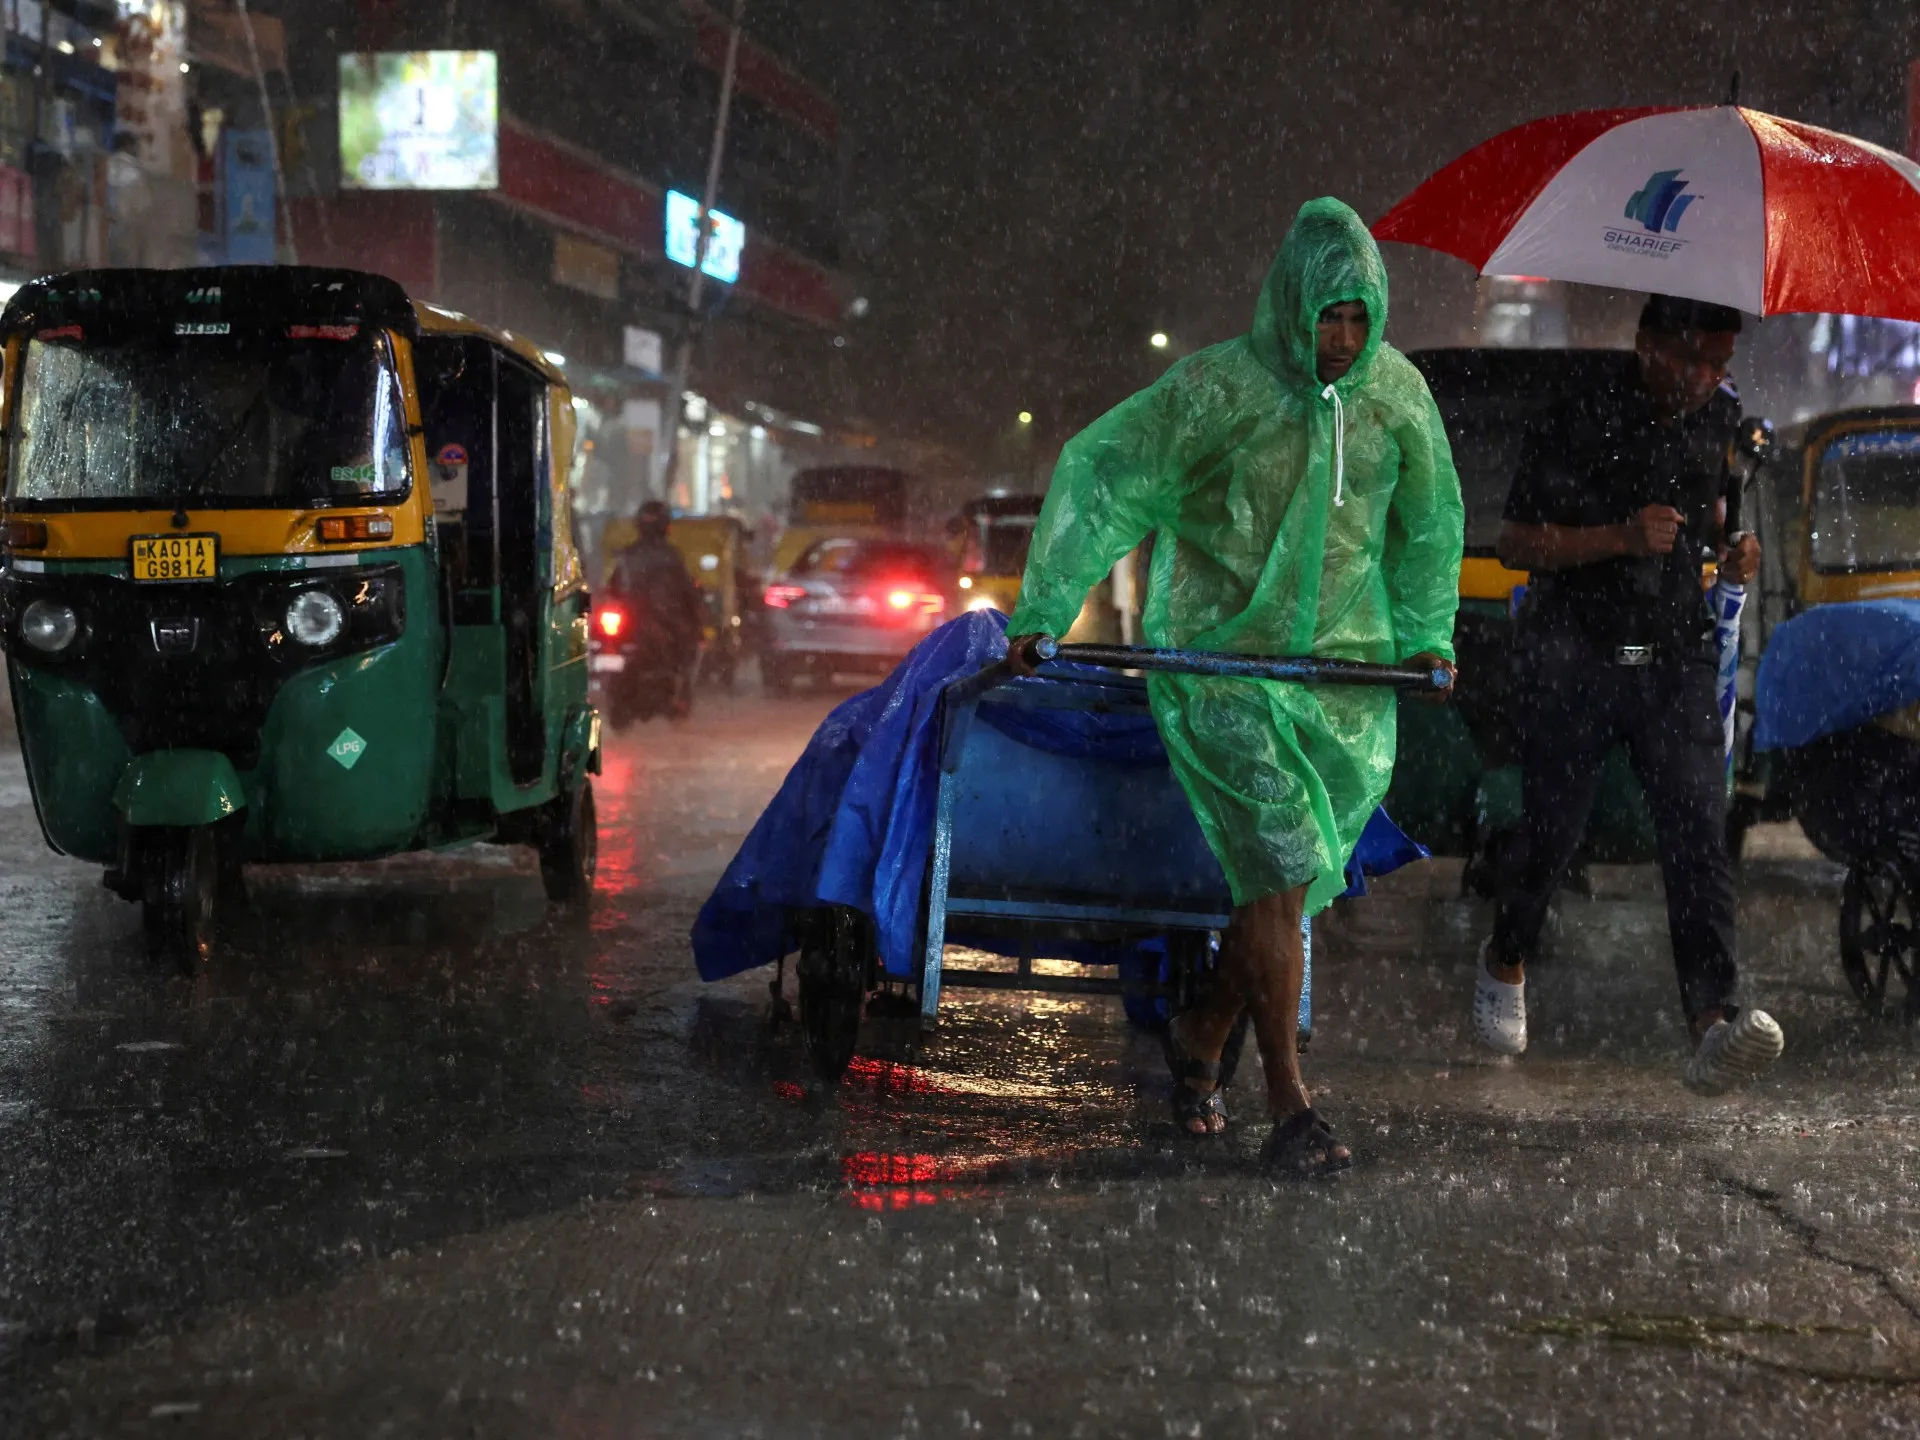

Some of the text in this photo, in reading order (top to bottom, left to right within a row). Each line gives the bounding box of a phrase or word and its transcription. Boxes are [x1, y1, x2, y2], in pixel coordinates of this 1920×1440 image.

[1604, 231, 1683, 253] SHARIEF
[147, 540, 204, 559] KA01A
[148, 559, 206, 577] G9814
[336, 740, 360, 755] LPG
